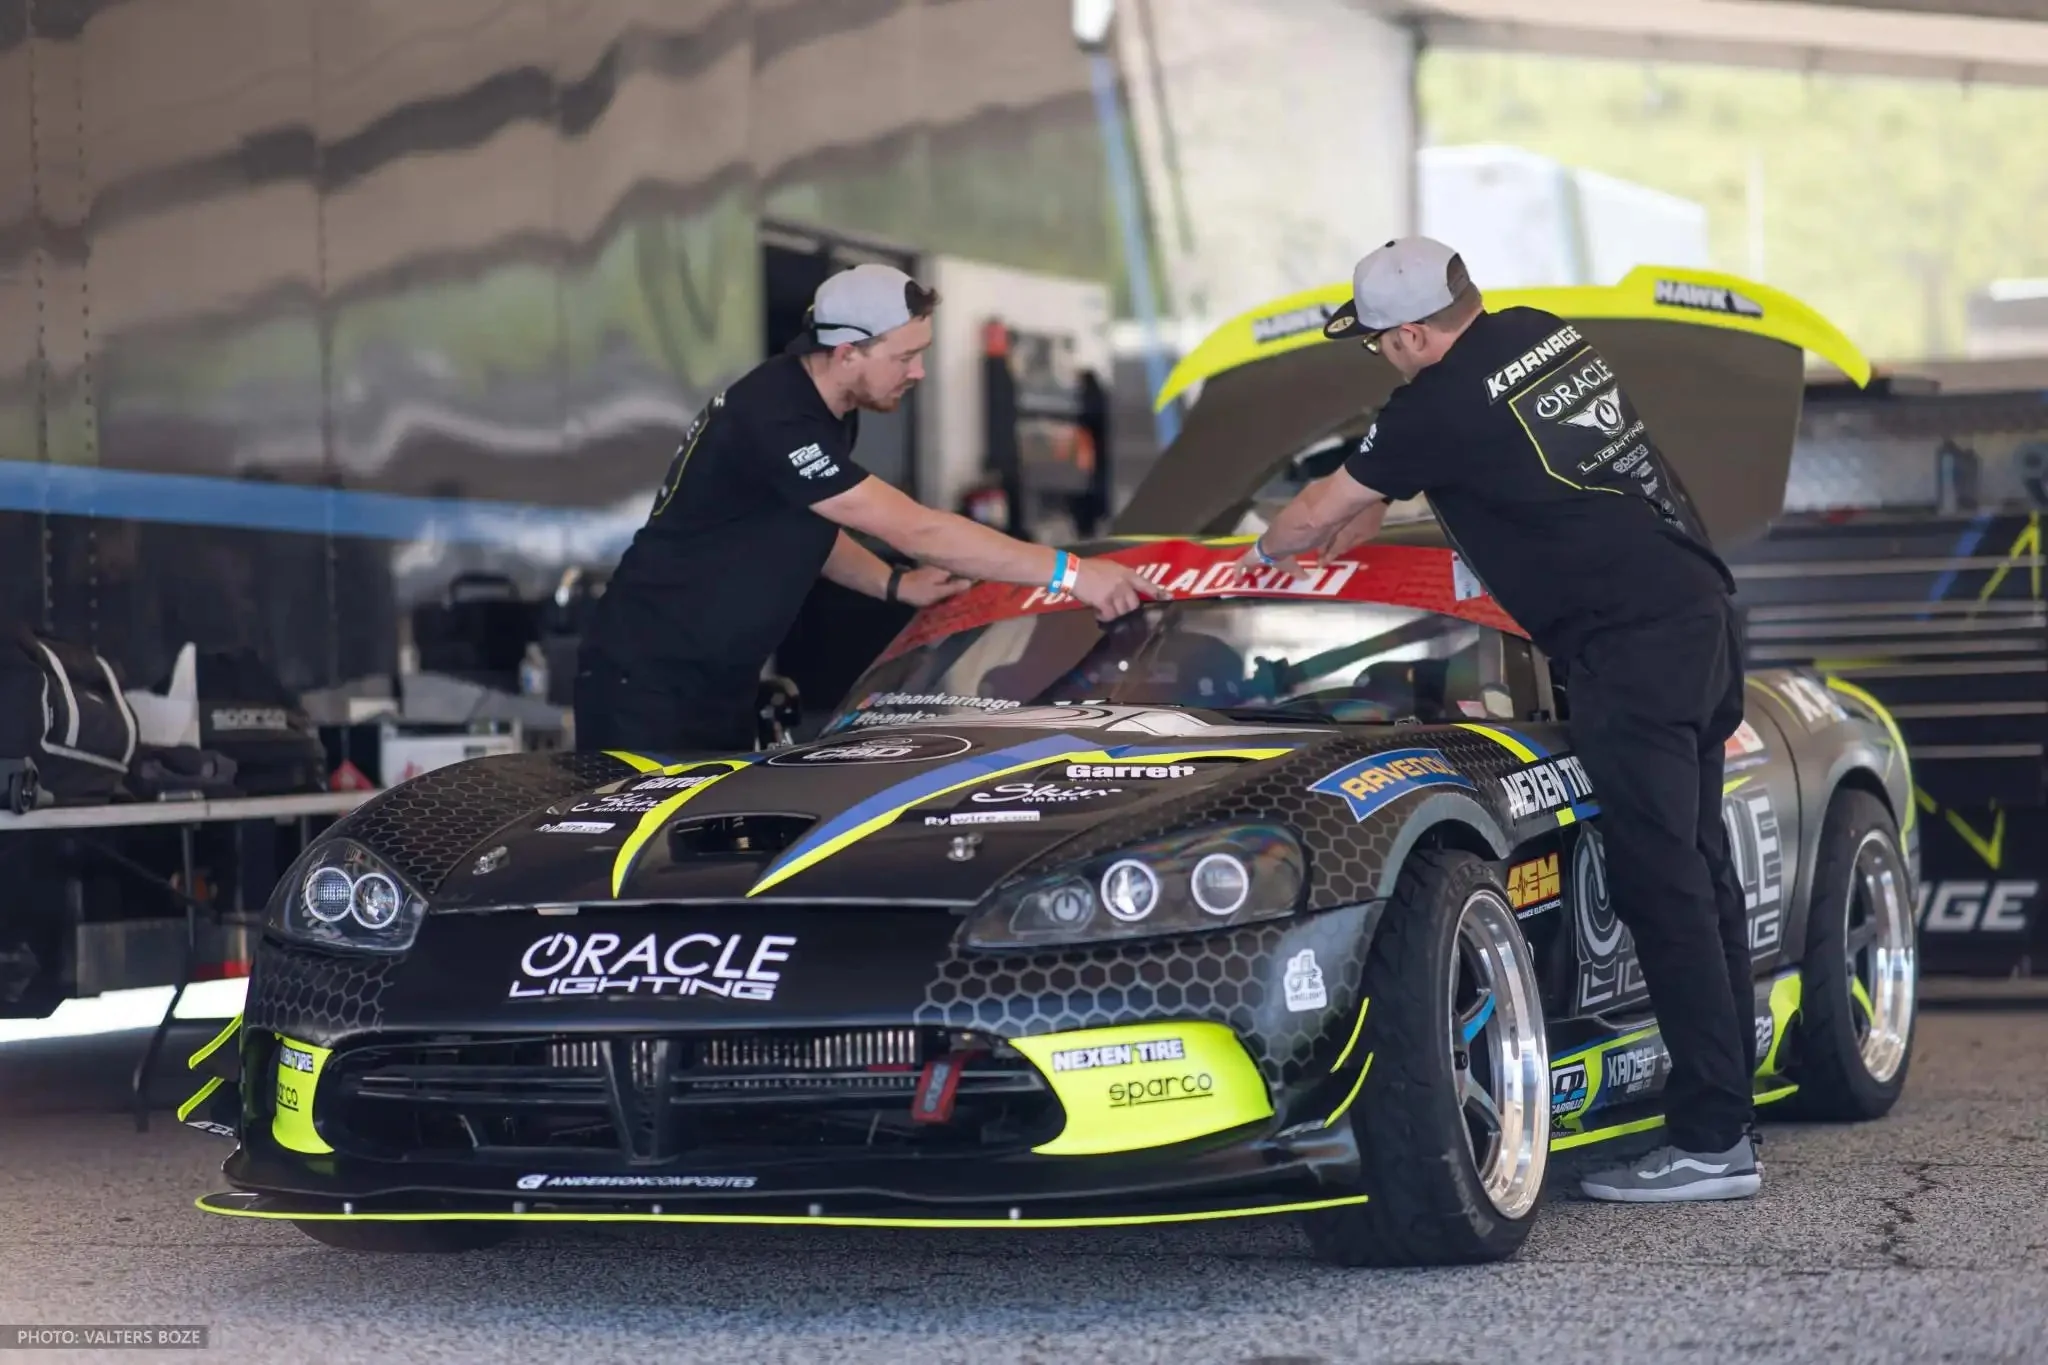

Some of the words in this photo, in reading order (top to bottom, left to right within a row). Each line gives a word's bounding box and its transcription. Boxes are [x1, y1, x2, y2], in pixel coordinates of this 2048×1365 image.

[1487, 325, 1582, 399] KARNAGE
[1536, 358, 1615, 418] ORACLE
[1581, 420, 1645, 472] LIGHTING
[1500, 763, 1569, 819] NEXEN
[521, 932, 797, 982] ORACLE
[509, 975, 777, 1001] LIGHTING
[1053, 1045, 1132, 1071] NEXEN
[1137, 1040, 1185, 1061] TIRE
[1109, 1073, 1213, 1107] sparco
